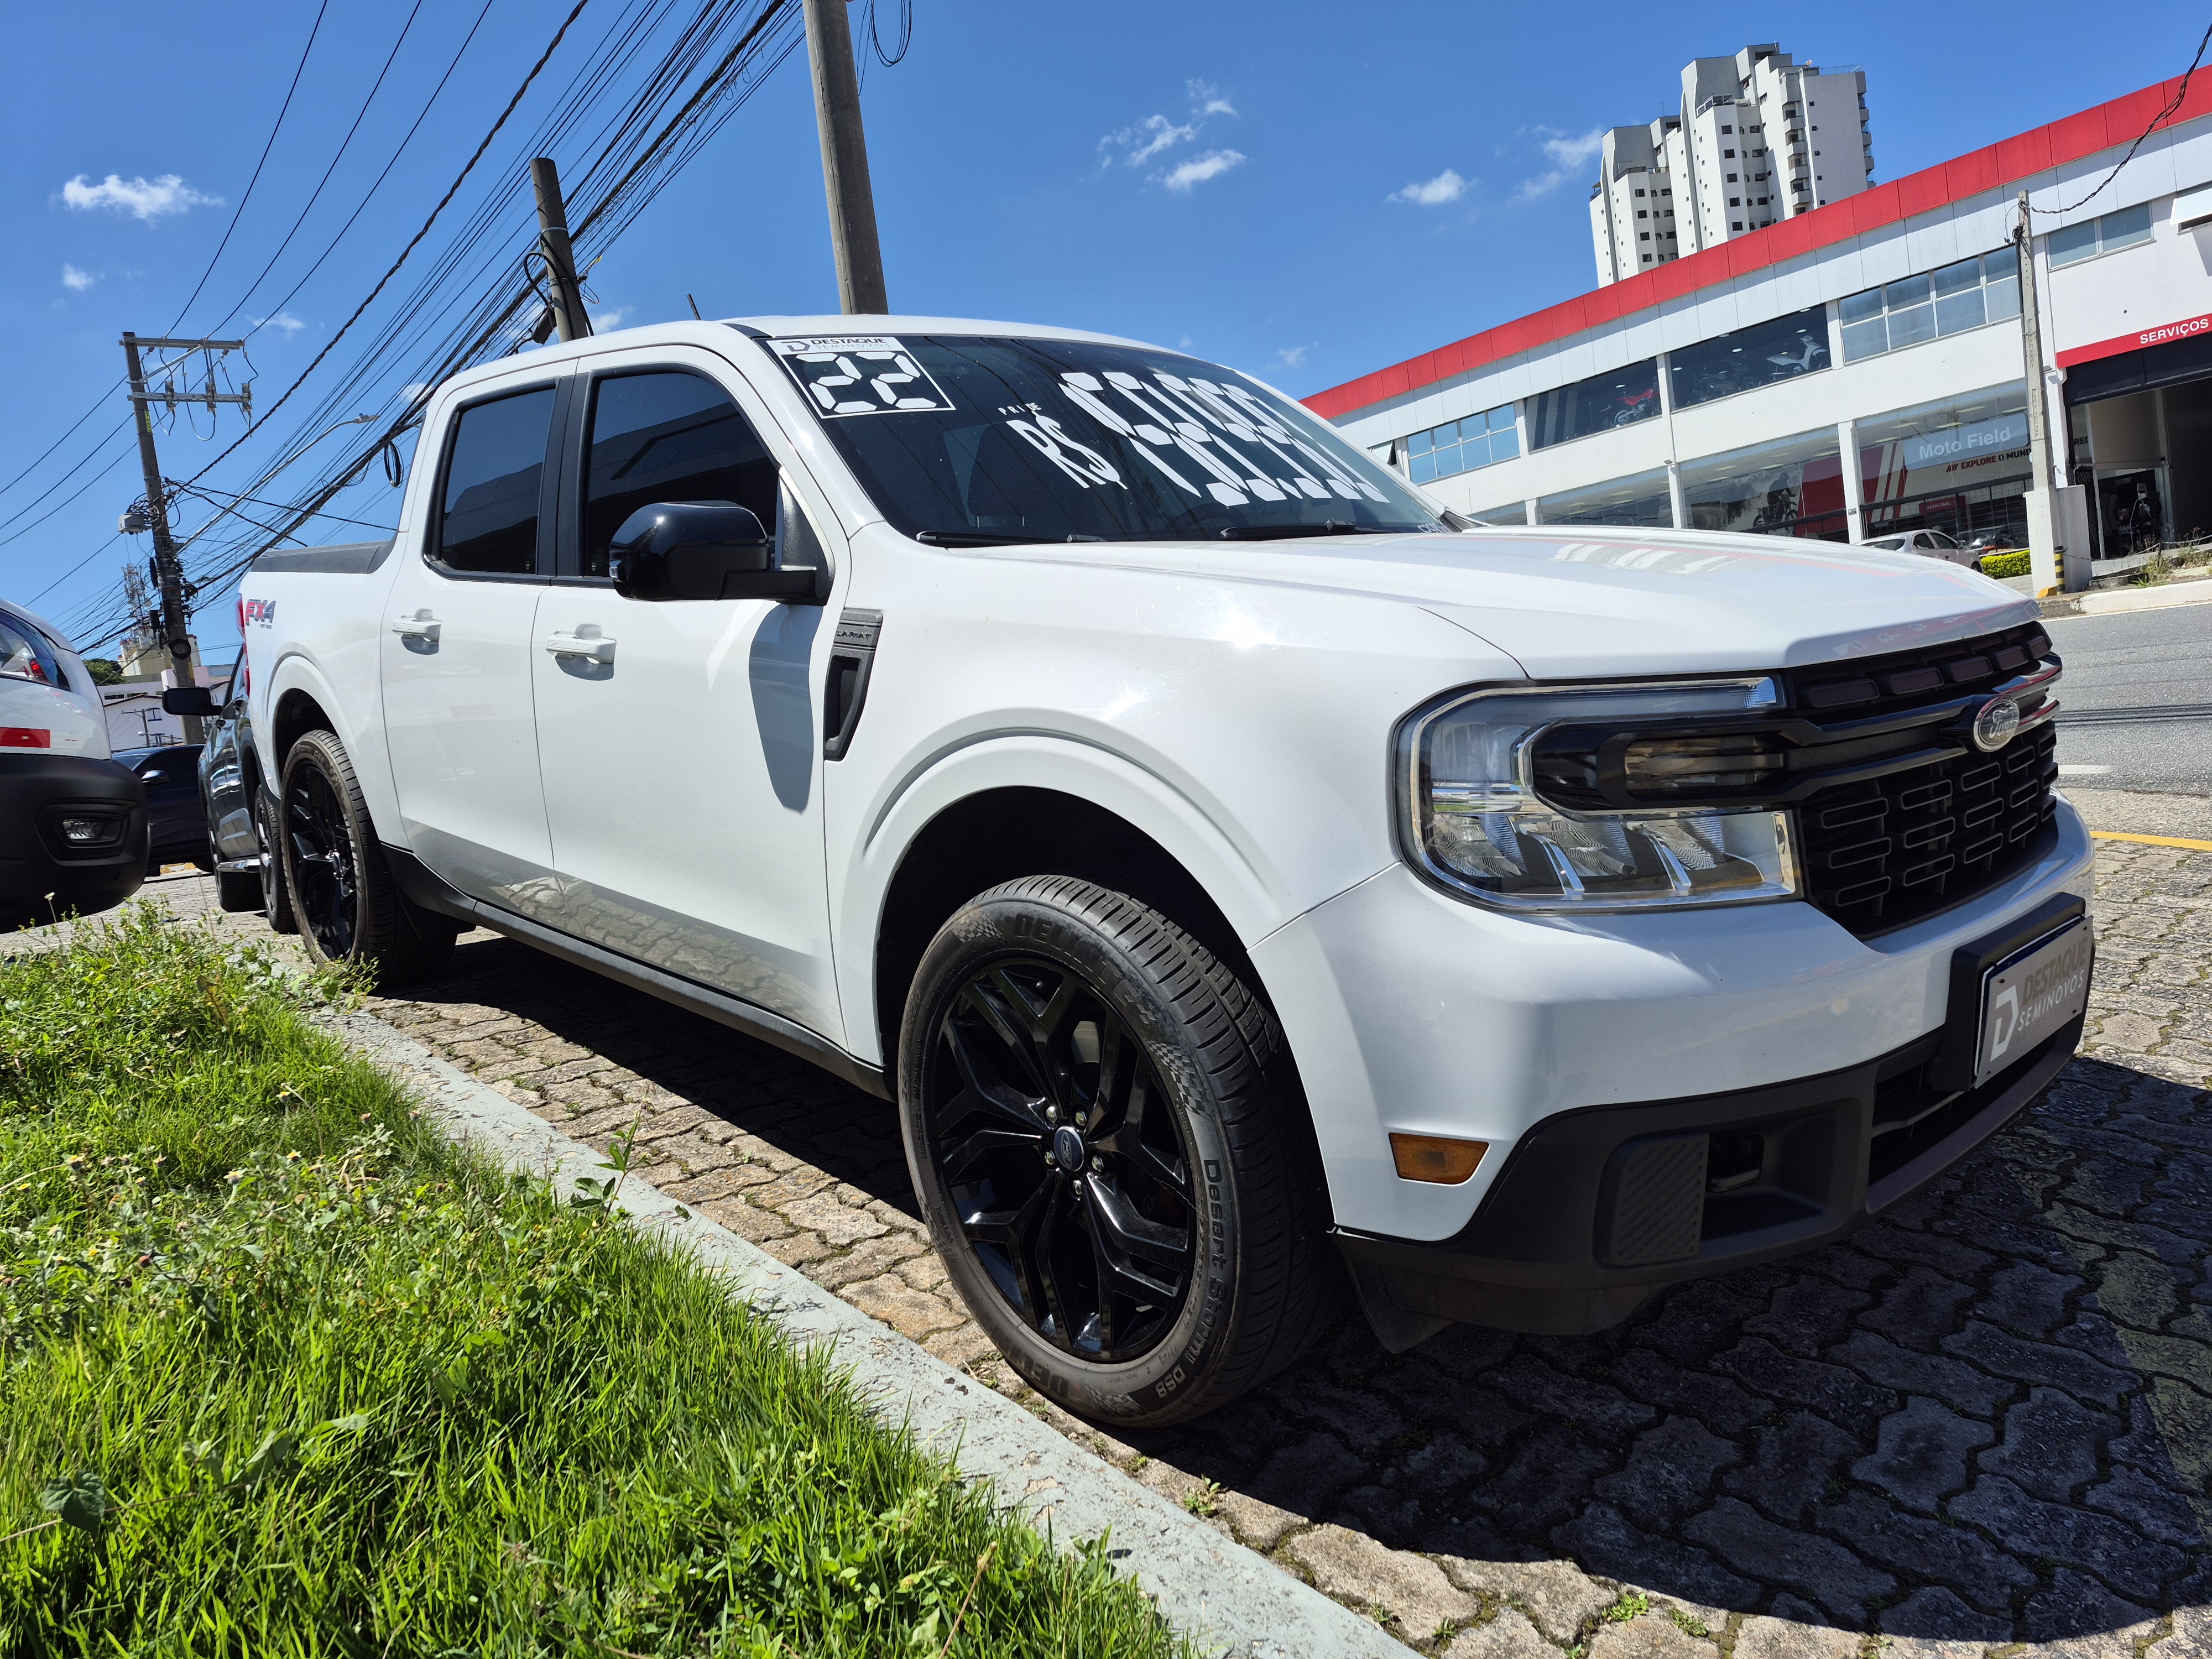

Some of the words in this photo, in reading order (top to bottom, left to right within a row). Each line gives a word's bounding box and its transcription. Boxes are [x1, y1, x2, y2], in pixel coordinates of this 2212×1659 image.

[2140, 318, 2209, 344] SERVIÇOS
[795, 351, 937, 414] 22
[1005, 410, 1128, 489] R$
[1919, 440, 1961, 460] Moto
[1967, 426, 2011, 449] Field
[1961, 456, 1997, 469] EXPLORE
[245, 599, 276, 626] FX4
[836, 630, 872, 640] LARIAT
[2022, 937, 2088, 1008] DESTAQUE
[2018, 969, 2084, 1032] SEMINOVOS
[1203, 1159, 1227, 1270] Desert
[1155, 1363, 1186, 1399] DS8
